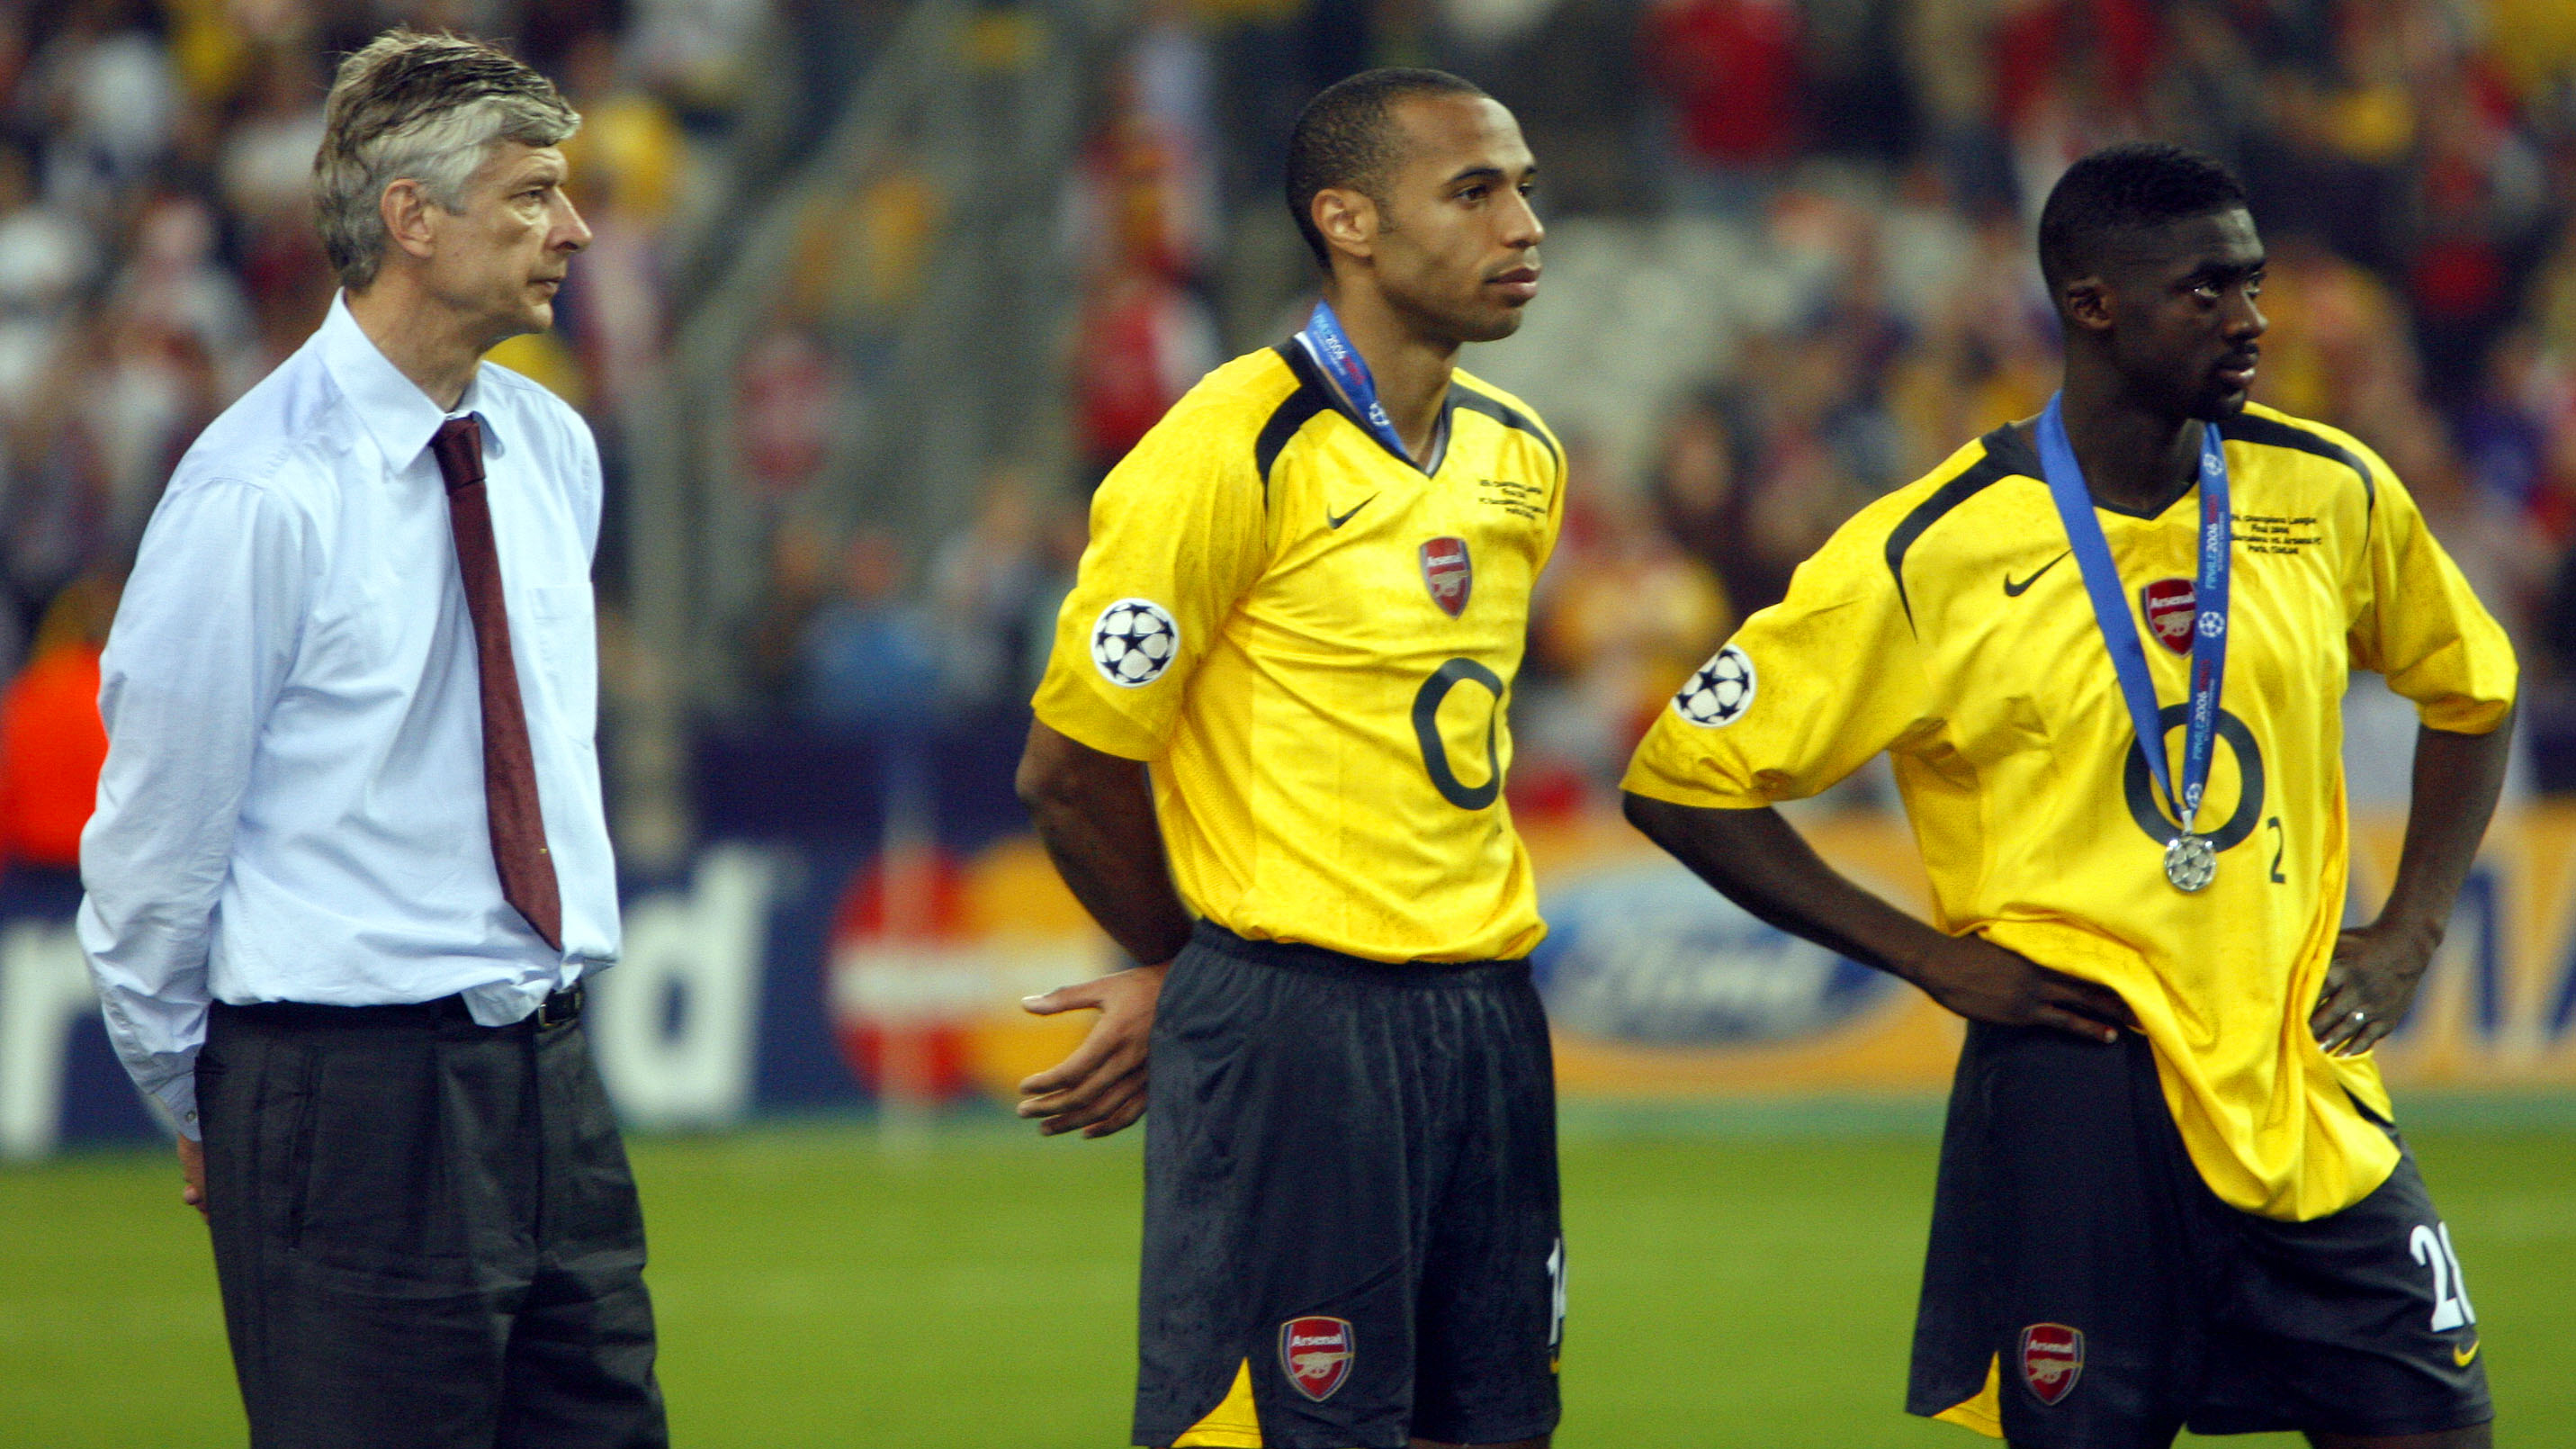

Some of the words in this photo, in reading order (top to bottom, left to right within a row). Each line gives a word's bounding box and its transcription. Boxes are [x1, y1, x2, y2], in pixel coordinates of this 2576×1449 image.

[2206, 523, 2219, 553] 2006
[2150, 590, 2195, 609] Arsenal
[2195, 690, 2209, 722] 2006
[1292, 1333, 1343, 1347] Arsenal
[2029, 1339, 2074, 1354] Arsenal
